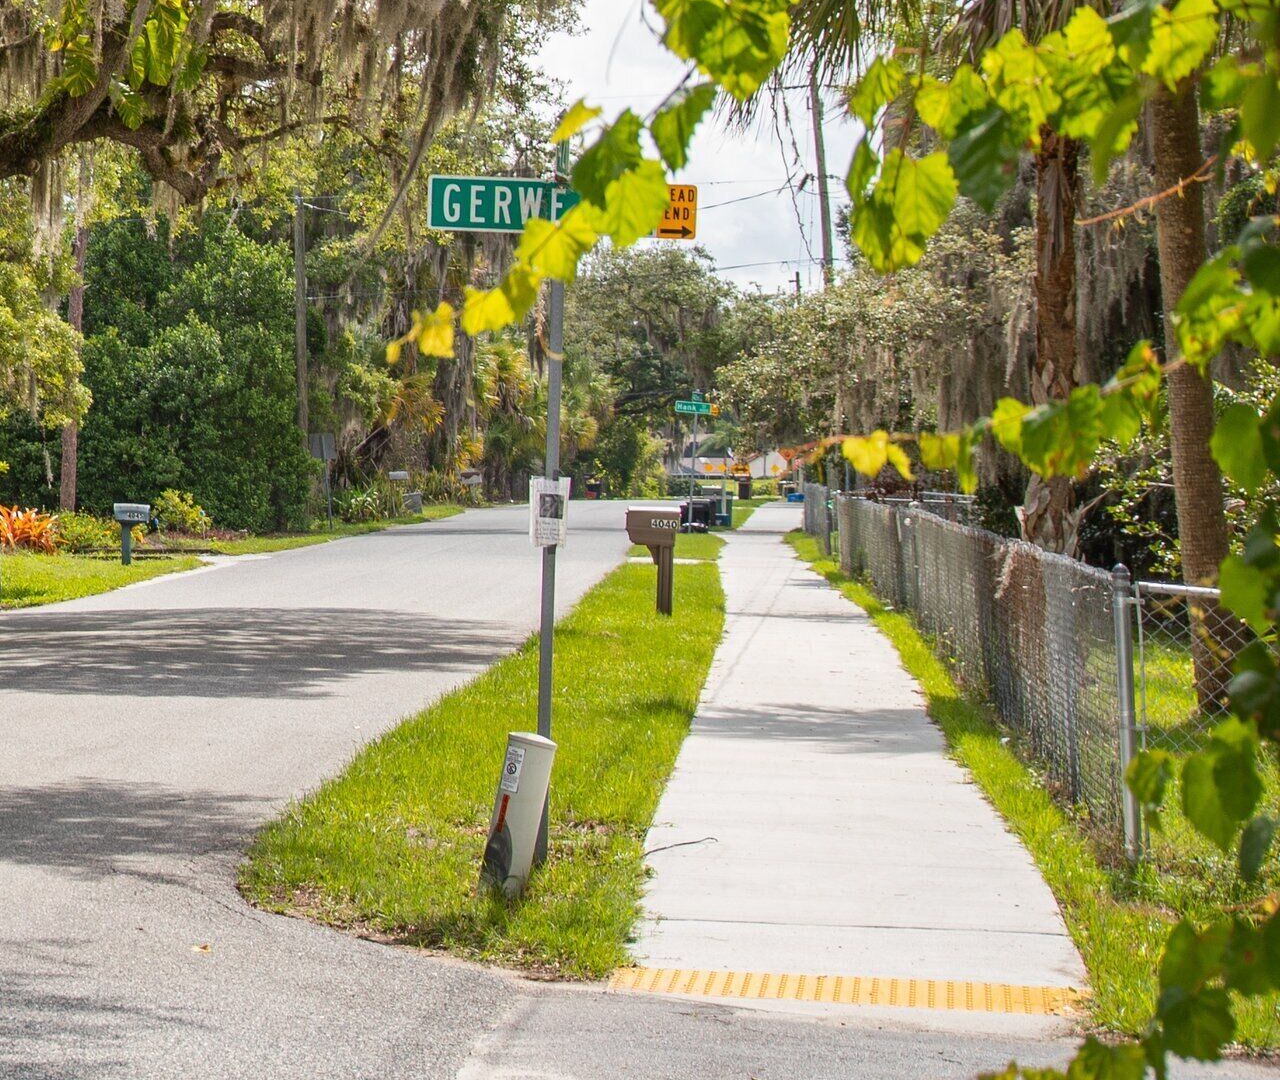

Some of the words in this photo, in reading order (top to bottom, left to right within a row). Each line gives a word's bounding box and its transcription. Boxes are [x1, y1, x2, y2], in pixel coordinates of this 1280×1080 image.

[670, 188, 695, 203] EAD
[664, 207, 690, 220] END
[651, 519, 678, 529] 4040
